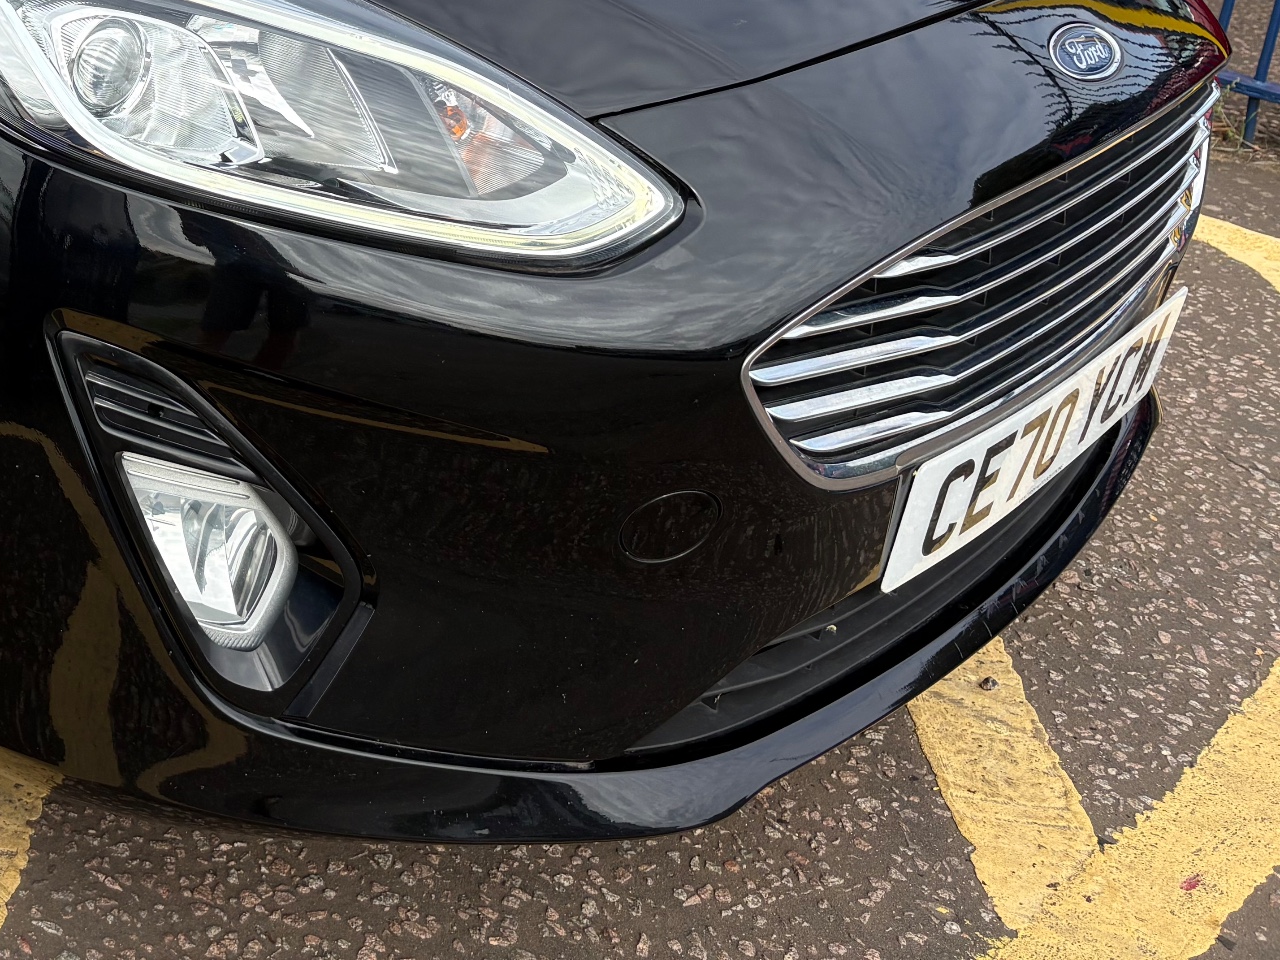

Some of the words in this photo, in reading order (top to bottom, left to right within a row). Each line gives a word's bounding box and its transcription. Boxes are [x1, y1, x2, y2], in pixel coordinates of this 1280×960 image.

[1064, 35, 1108, 69] Ford
[921, 387, 1081, 557] CE70
[1077, 311, 1172, 446] YCM
